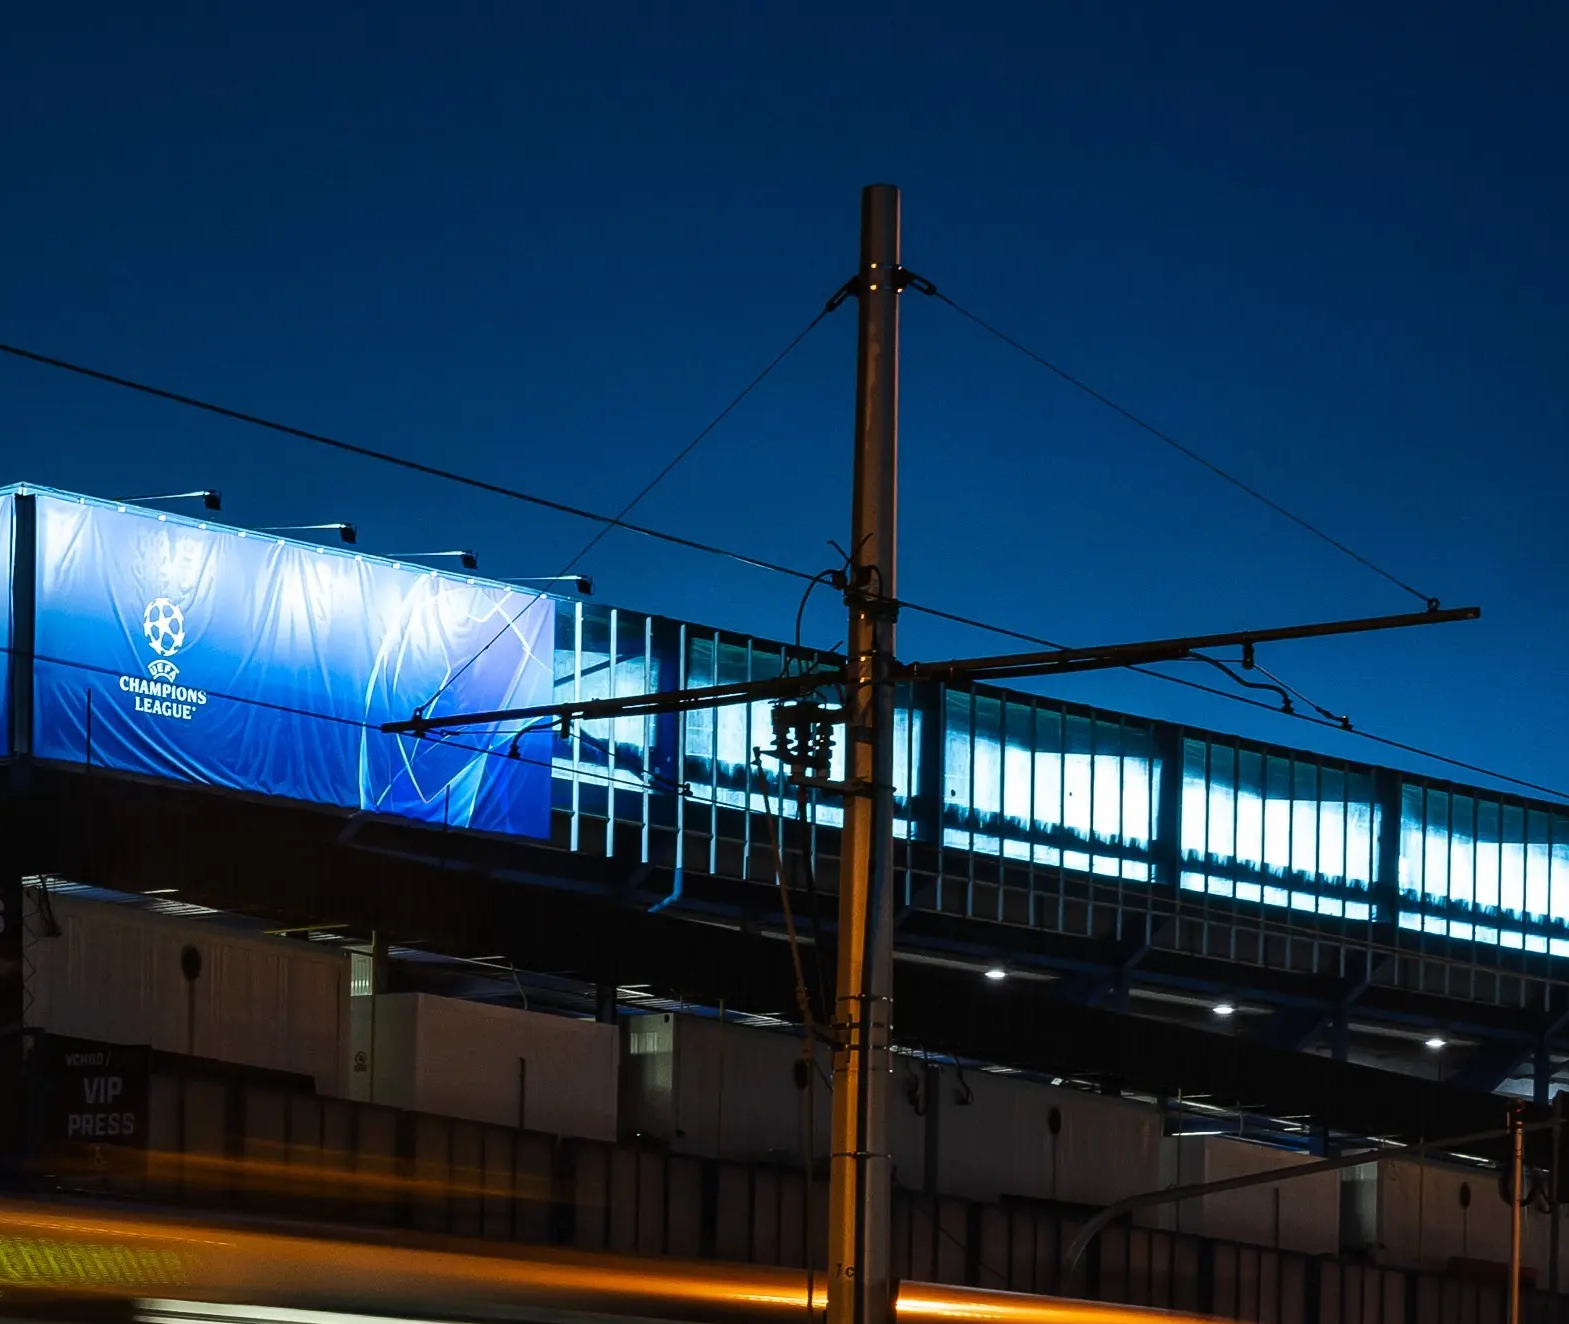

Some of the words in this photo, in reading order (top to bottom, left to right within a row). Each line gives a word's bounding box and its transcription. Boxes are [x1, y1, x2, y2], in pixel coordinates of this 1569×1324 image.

[119, 675, 207, 705] CHAMPIONS
[82, 1075, 123, 1105] VIP
[67, 1112, 135, 1138] PRESS
